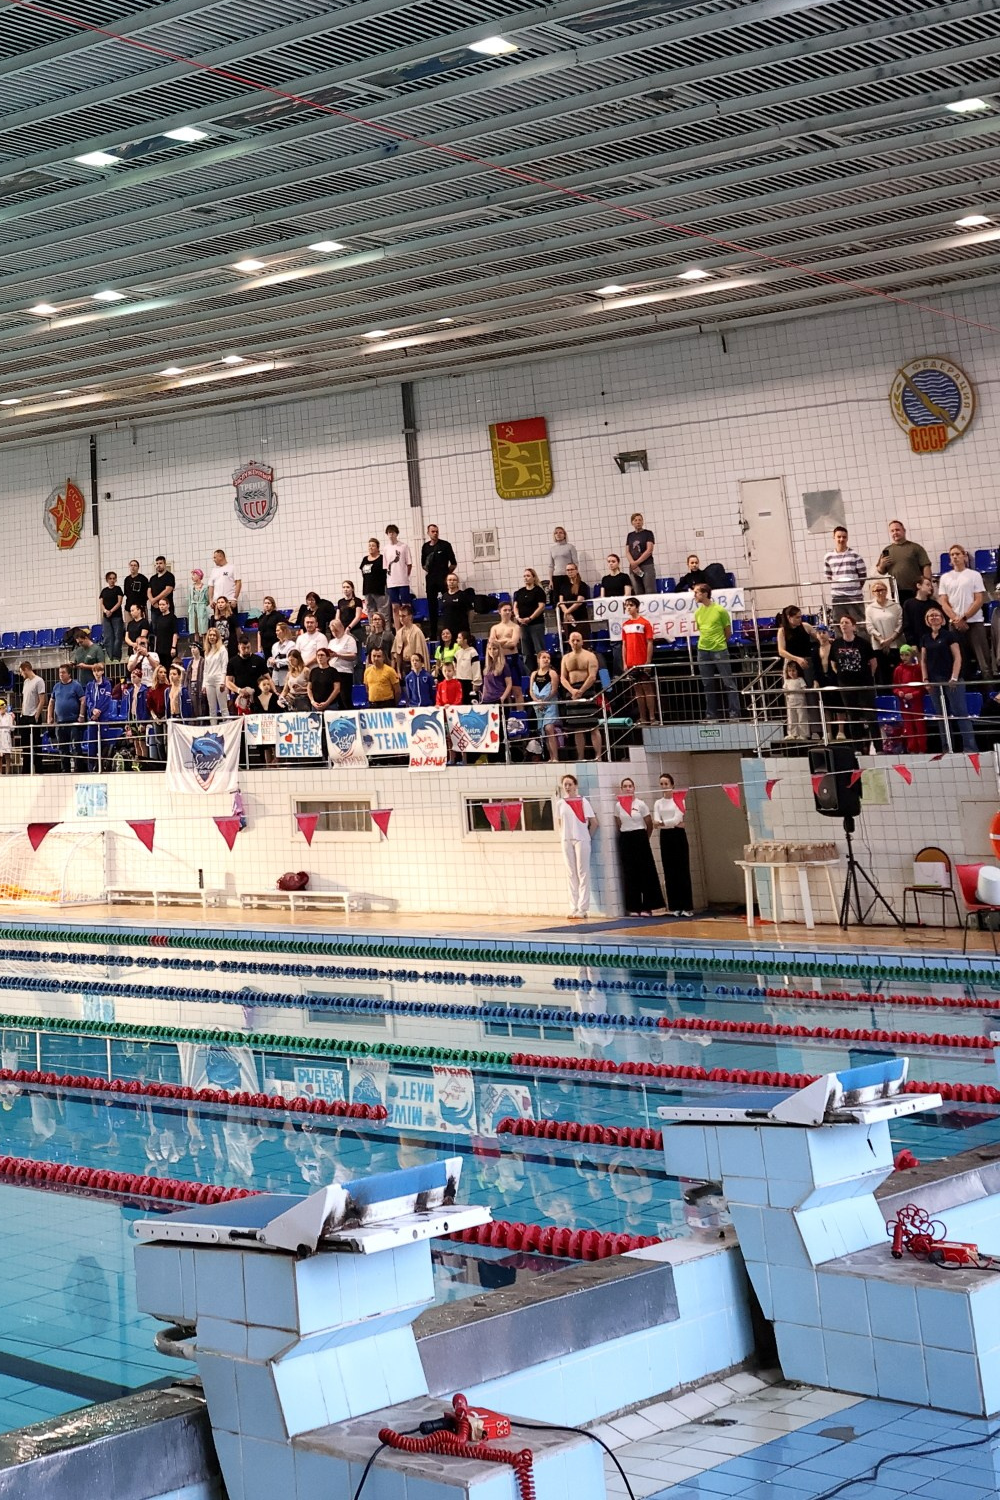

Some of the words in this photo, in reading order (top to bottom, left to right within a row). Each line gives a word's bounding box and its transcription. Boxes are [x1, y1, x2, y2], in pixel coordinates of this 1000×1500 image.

[911, 360, 971, 409] ФЕДЕРАЦИЯ
[910, 426, 947, 451] СССР
[68, 488, 82, 514] СССР
[243, 500, 267, 518] СССР
[639, 594, 744, 613] СОКОЛВА
[360, 711, 394, 730] SWIM
[374, 732, 409, 750] TEAM
